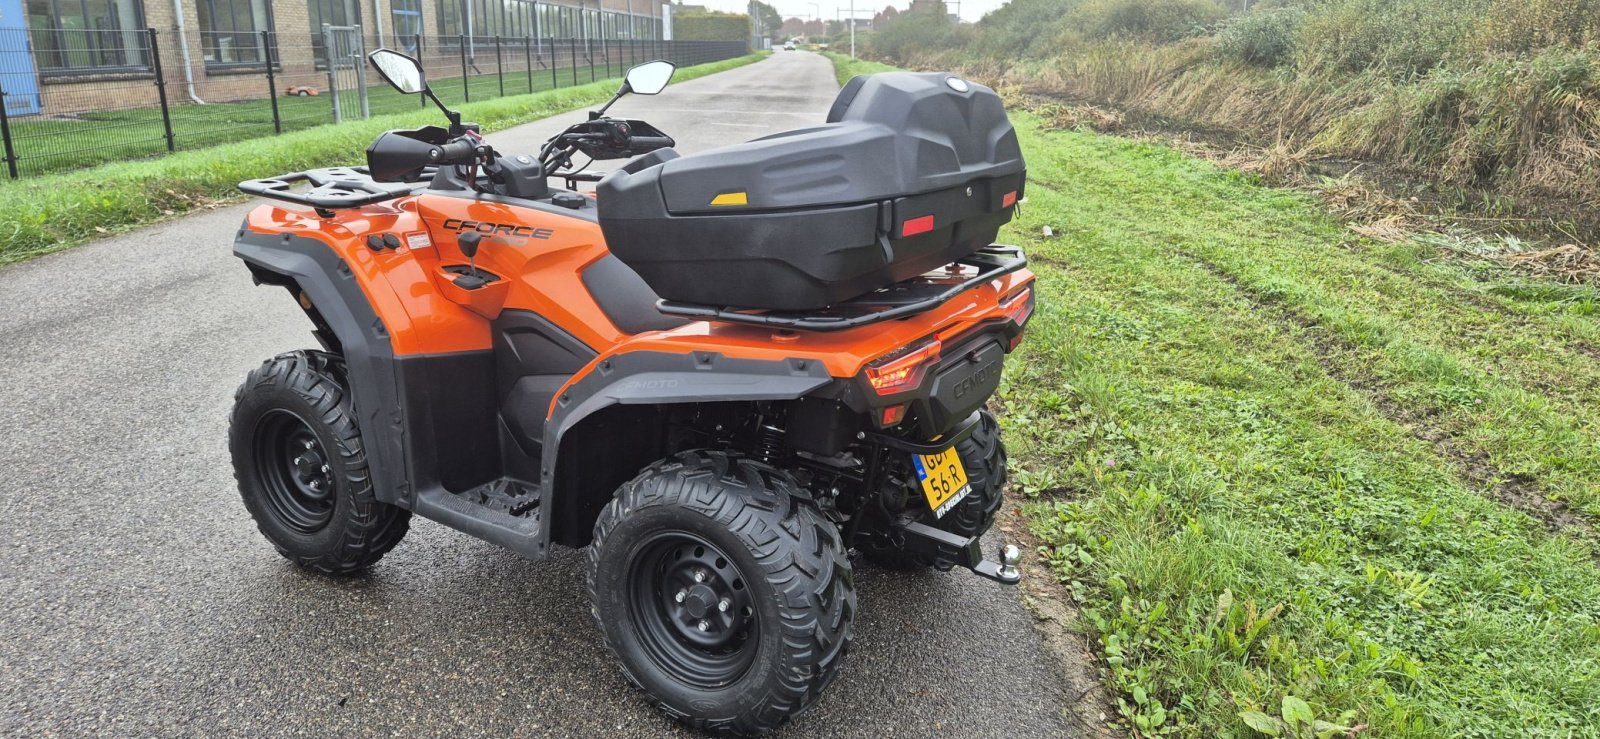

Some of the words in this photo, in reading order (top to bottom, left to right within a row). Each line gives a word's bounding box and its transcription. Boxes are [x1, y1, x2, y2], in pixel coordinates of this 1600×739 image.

[443, 218, 554, 240] CFORCE
[616, 379, 678, 393] CFMOTO
[953, 362, 998, 399] CFMOTO
